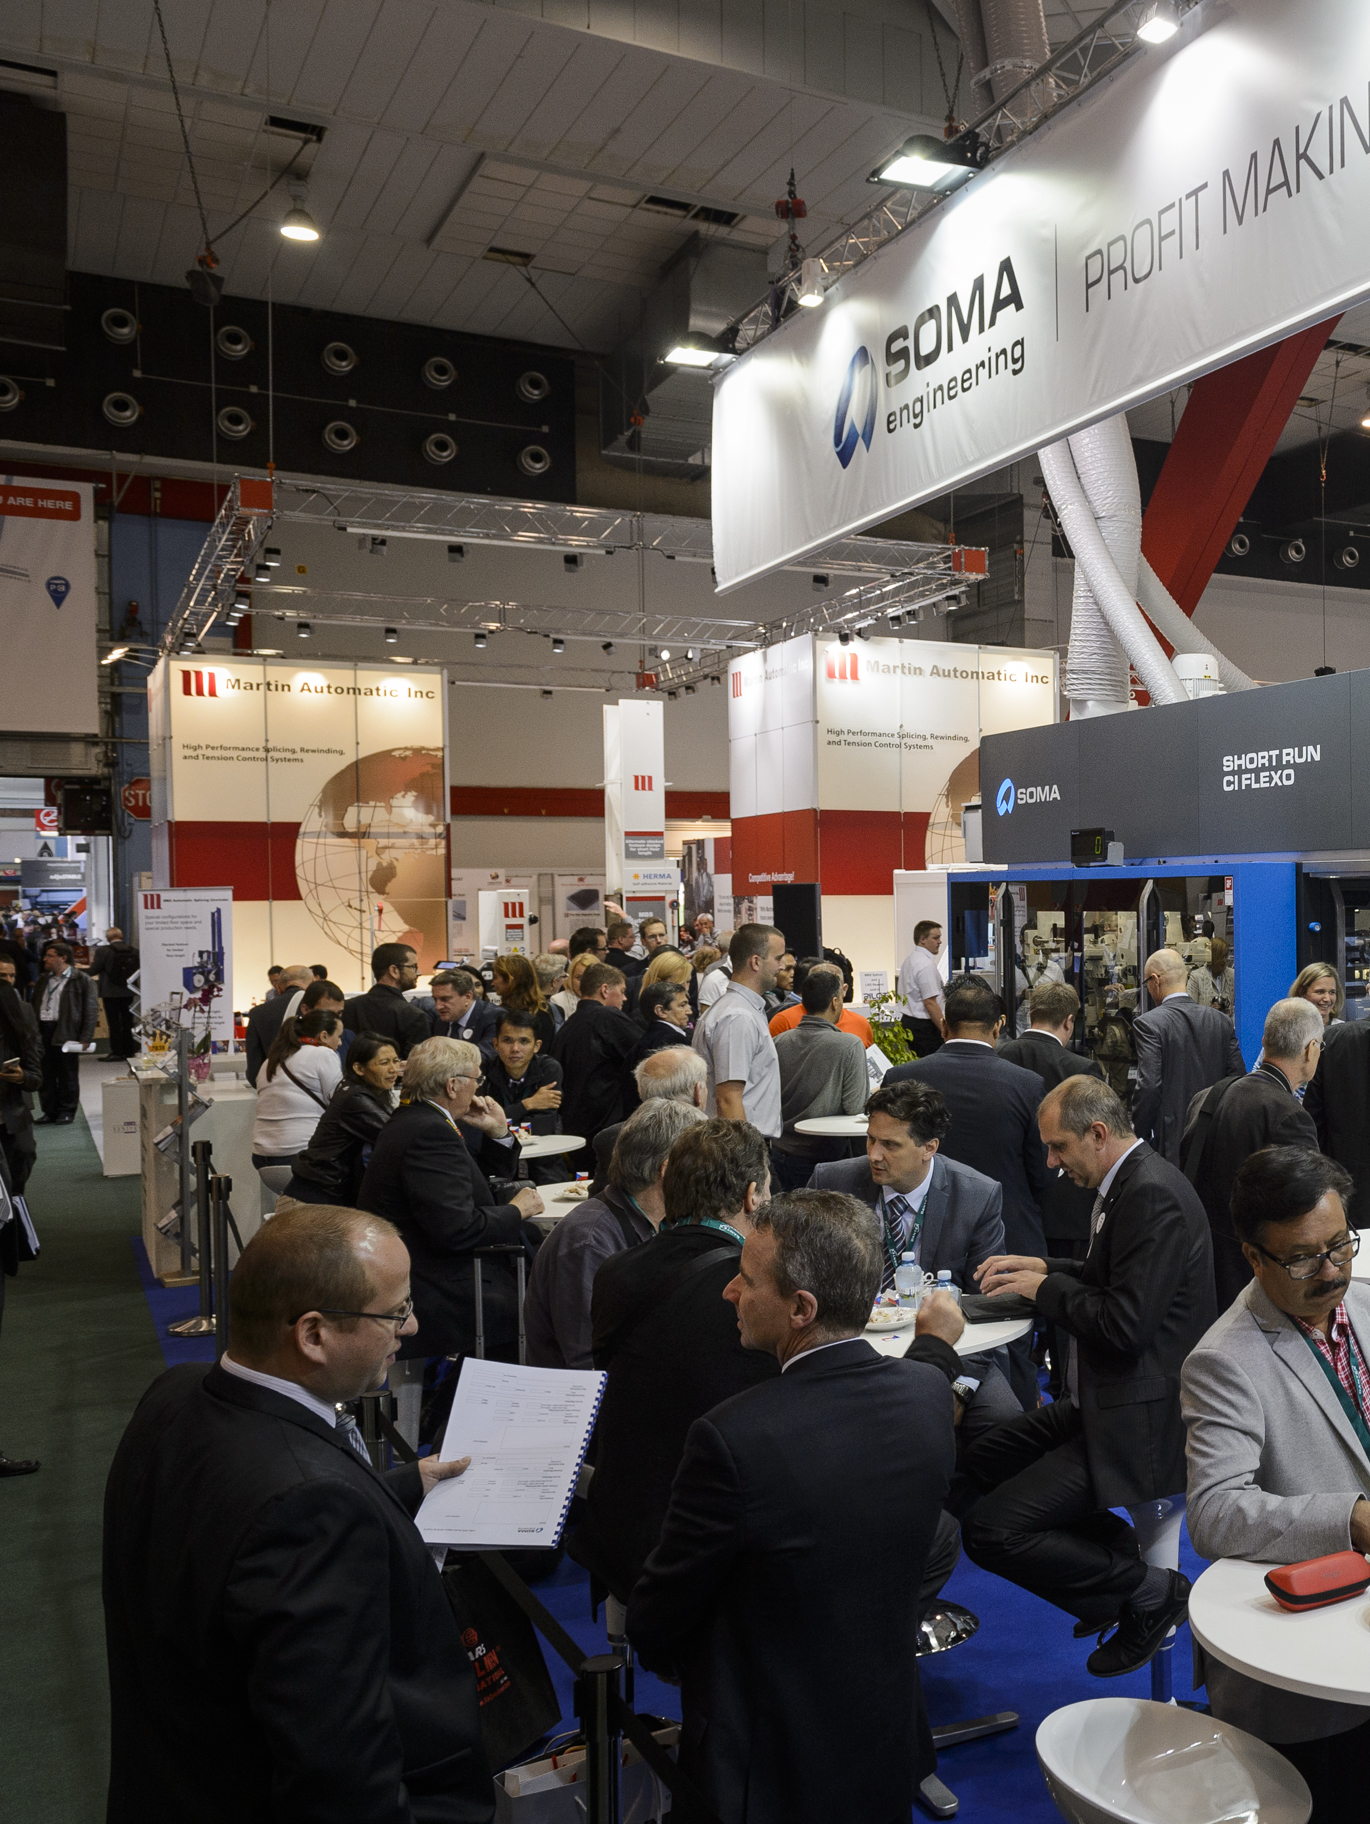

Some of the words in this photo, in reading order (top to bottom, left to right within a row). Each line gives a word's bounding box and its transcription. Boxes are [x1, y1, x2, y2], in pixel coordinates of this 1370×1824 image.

[1084, 182, 1208, 313] PROFIT
[885, 255, 1025, 389] SOMA
[886, 336, 1025, 434] engineering
[6, 496, 34, 507] ARE
[38, 499, 74, 510] HERE
[865, 659, 923, 676] Martin
[929, 665, 1018, 682] Automatic
[1024, 672, 1050, 685] Inc
[226, 678, 292, 693] Martin
[299, 682, 399, 699] Automatic
[407, 687, 436, 700] Inc
[827, 728, 846, 737] High
[847, 729, 895, 739] Performance
[896, 732, 929, 742] Splicing,
[930, 733, 970, 742] Rewinding,
[843, 740, 872, 748] Tension
[874, 741, 901, 749] Control
[903, 742, 934, 751] Systems
[182, 743, 204, 752] High
[205, 744, 261, 753] Performance
[262, 745, 298, 755] Splicing,
[300, 746, 346, 756] Rewinding,
[201, 754, 235, 762] Tension
[236, 755, 268, 763] Control
[269, 755, 304, 764] Systems
[1223, 749, 1279, 772] SHORT
[1281, 744, 1321, 764] RUN
[1223, 774, 1239, 792] CI
[1241, 768, 1295, 790] FLEXO
[1017, 784, 1061, 805] SOMA
